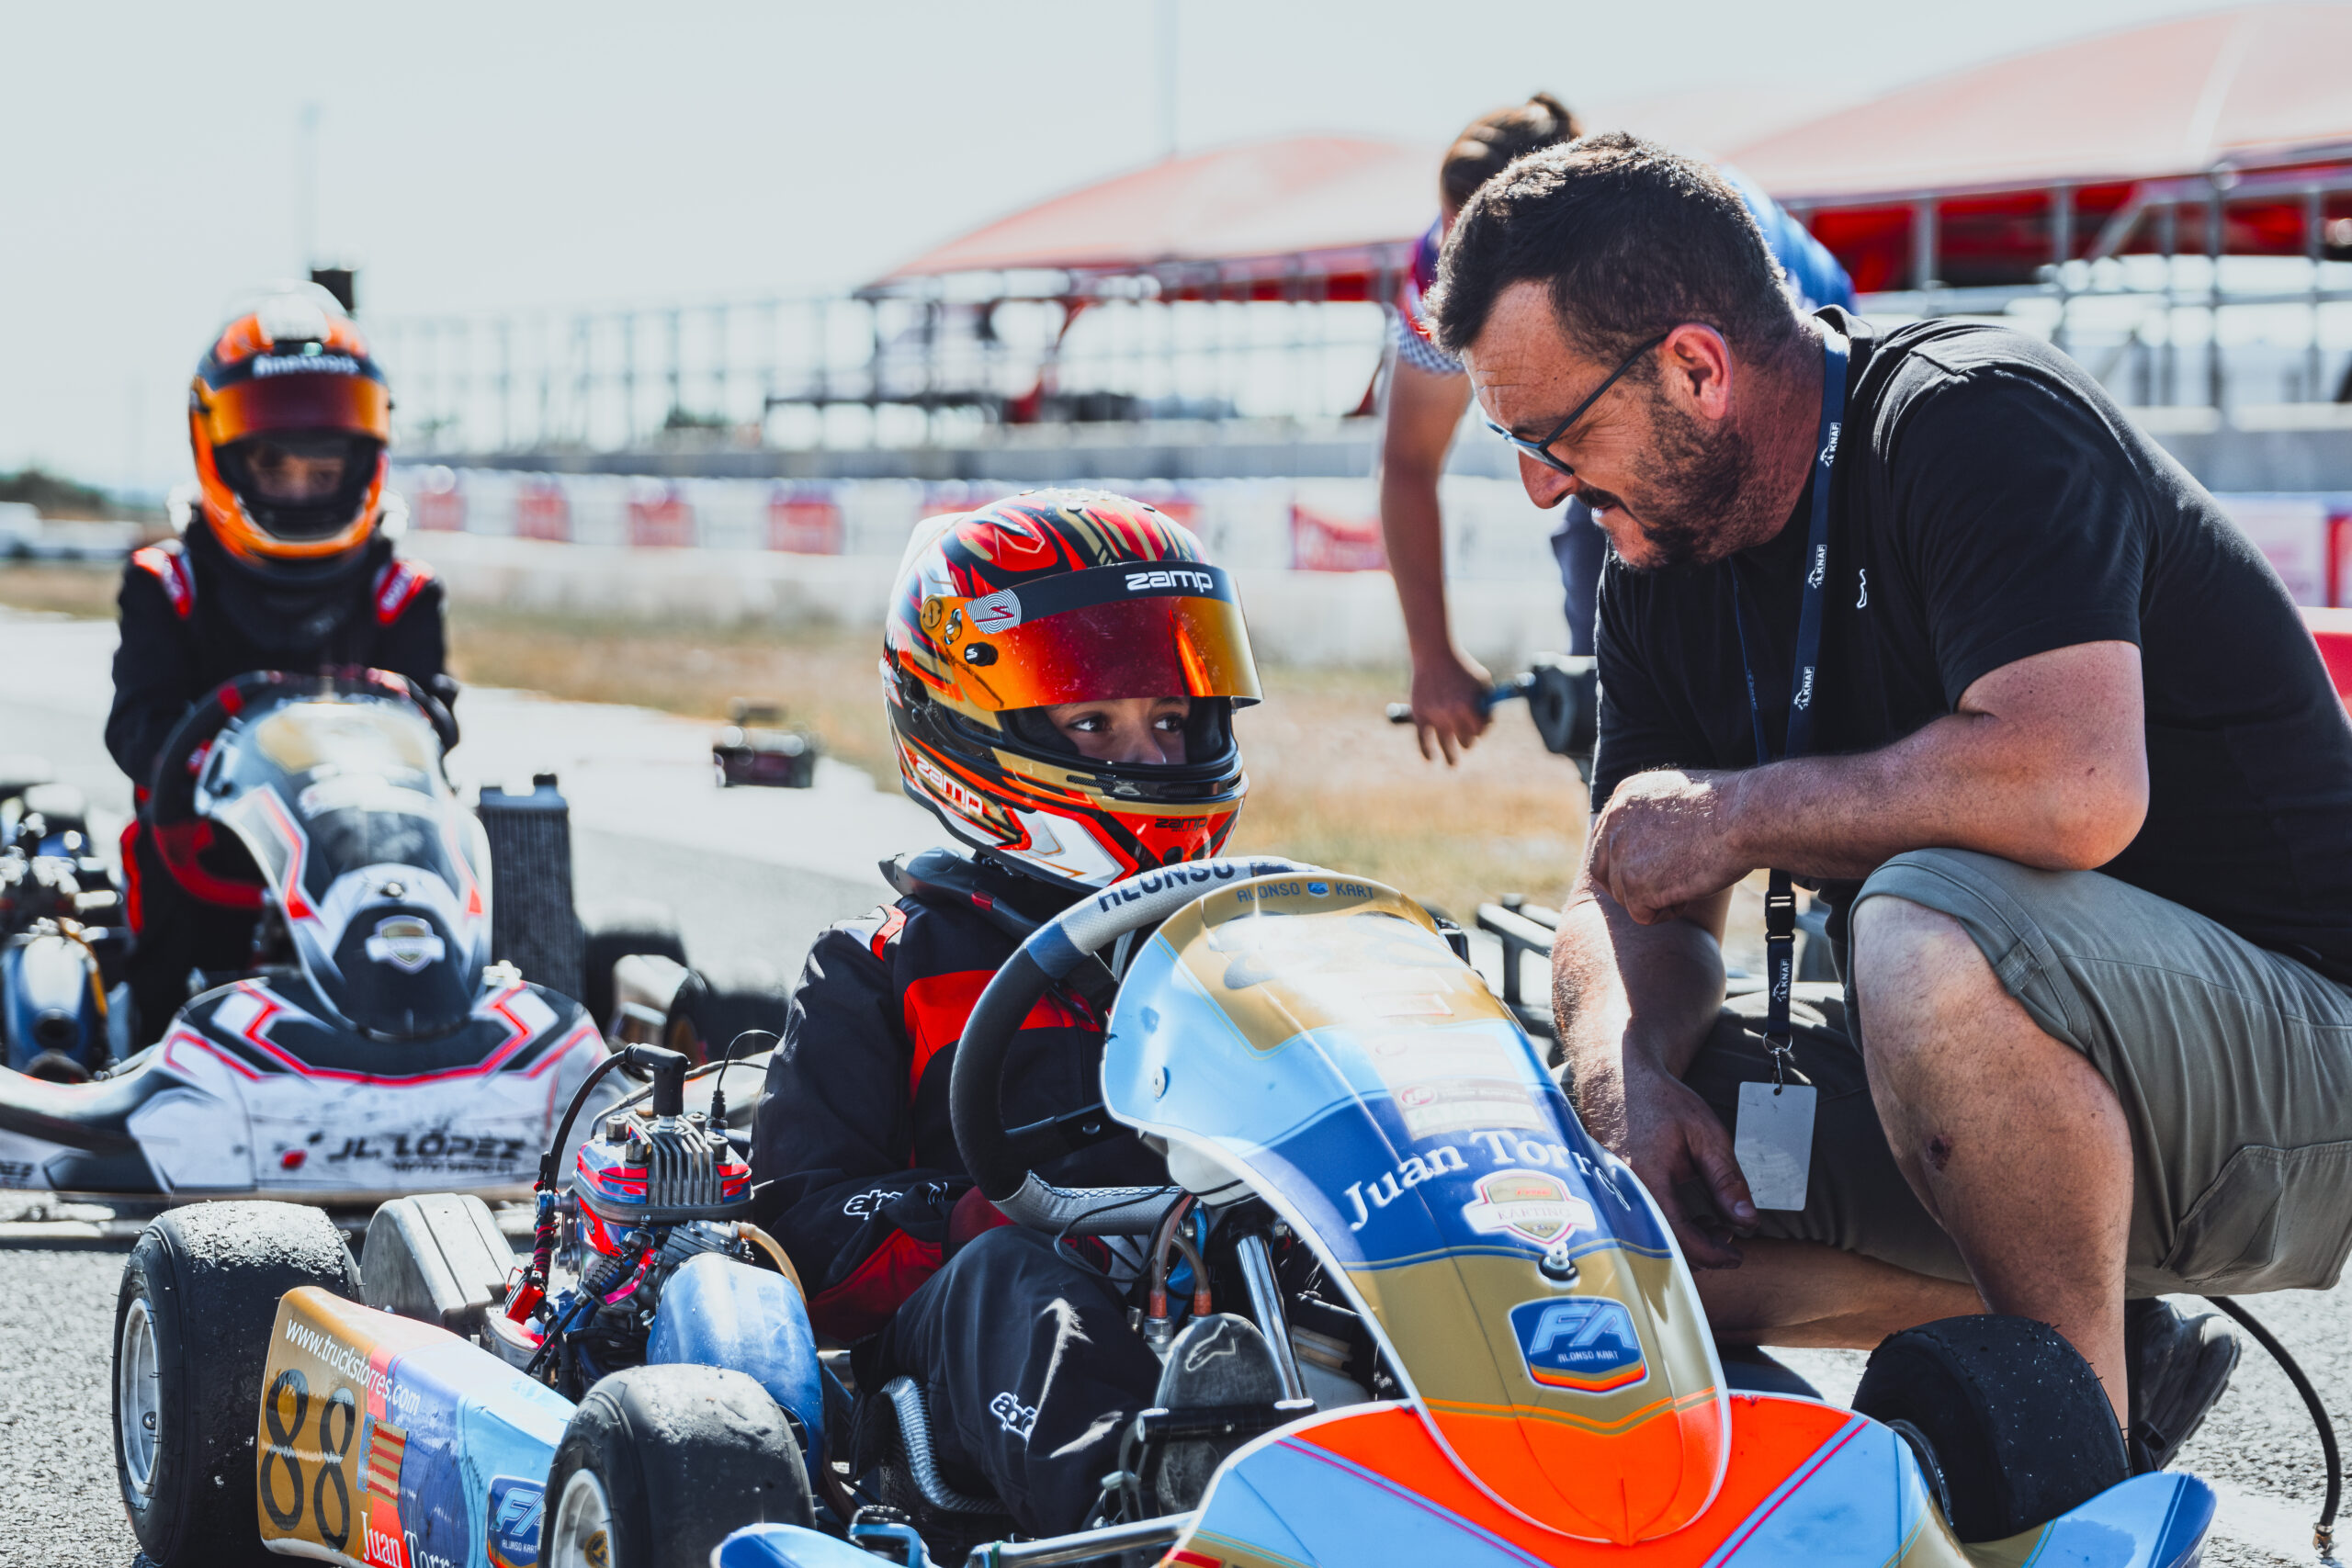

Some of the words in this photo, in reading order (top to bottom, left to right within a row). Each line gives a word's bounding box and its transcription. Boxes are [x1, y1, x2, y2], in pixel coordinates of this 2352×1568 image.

[1829, 423, 1839, 452] KNAF
[1816, 546, 1826, 574] KNAF
[1125, 570, 1214, 593] zamp
[1803, 668, 1813, 695] KNAF
[916, 754, 983, 816] zamp
[1155, 817, 1207, 830] zamp
[1236, 882, 1301, 903] ALONSO
[1335, 882, 1374, 899] KART
[1781, 960, 1790, 987] KNAF
[1344, 1145, 1469, 1232] Juan
[1529, 1303, 1638, 1355] FA
[286, 1319, 421, 1416] www.truckstorres.com
[1558, 1350, 1594, 1363] ALONSO
[1597, 1349, 1619, 1360] KART
[260, 1369, 356, 1553] 88
[360, 1510, 402, 1568] Juan
